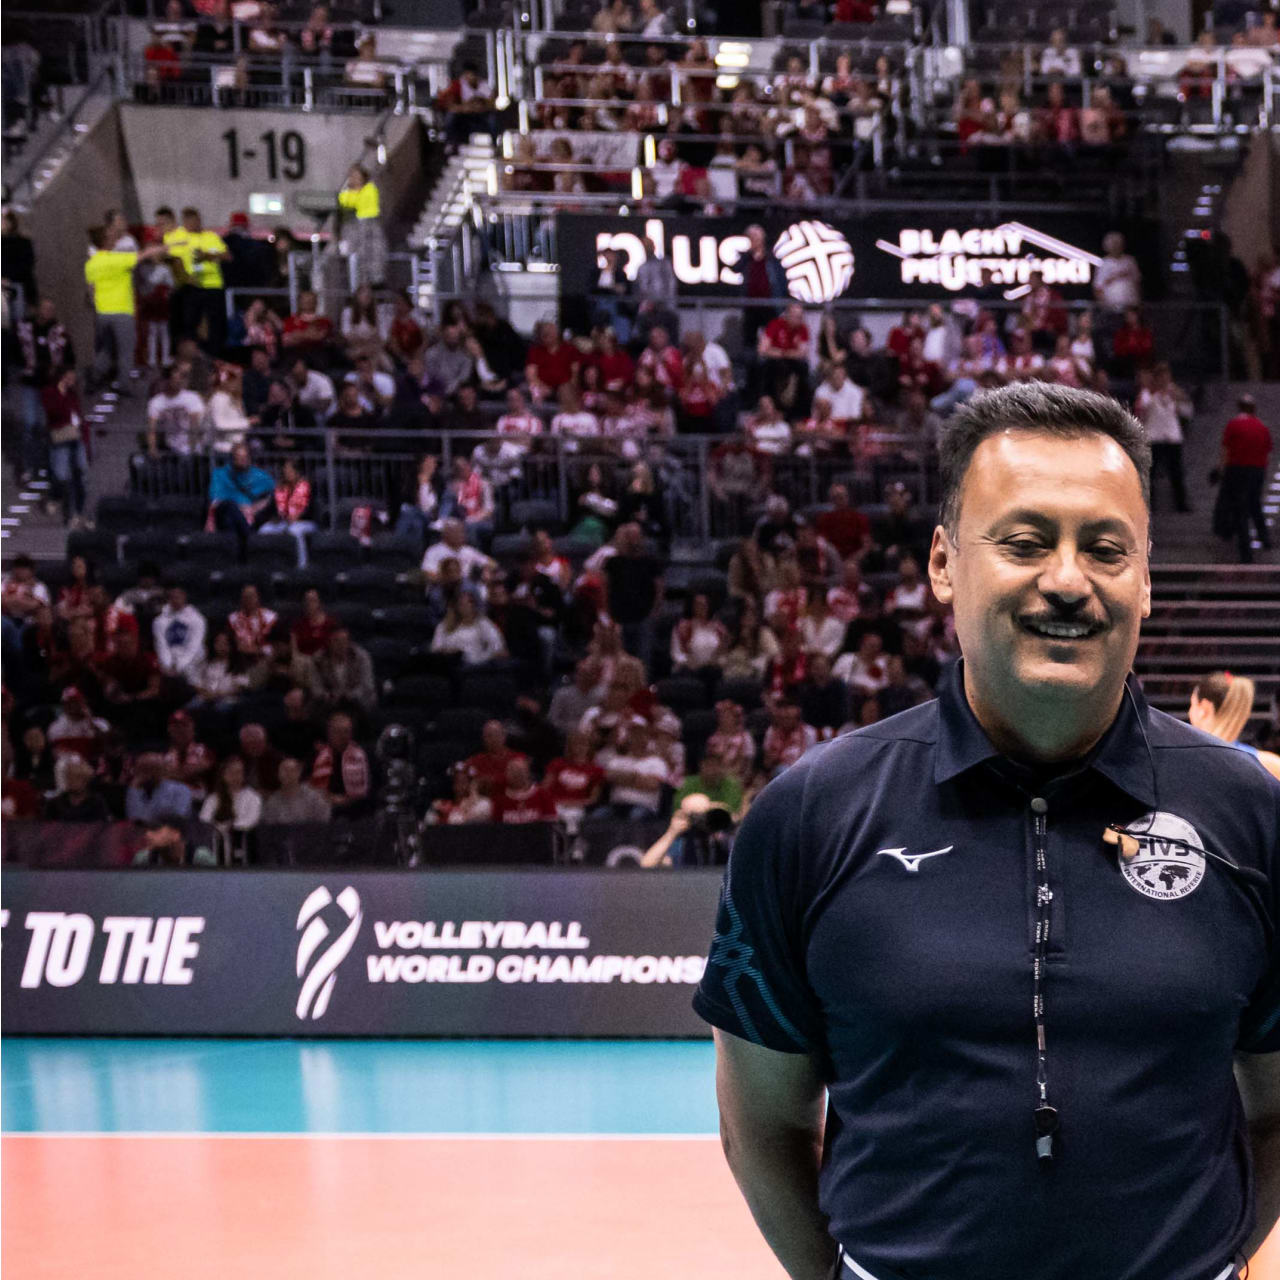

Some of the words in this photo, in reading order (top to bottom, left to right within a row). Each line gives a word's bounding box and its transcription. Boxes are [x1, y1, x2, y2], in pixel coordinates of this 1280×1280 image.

[223, 128, 308, 181] 1-19
[1124, 867, 1178, 898] INTERNATIONAL
[20, 912, 95, 988] TO
[99, 917, 206, 985] THE
[374, 921, 589, 949] VOLLEYBALL
[366, 955, 495, 983] WORLD
[496, 955, 708, 984] CHAMPIONS
